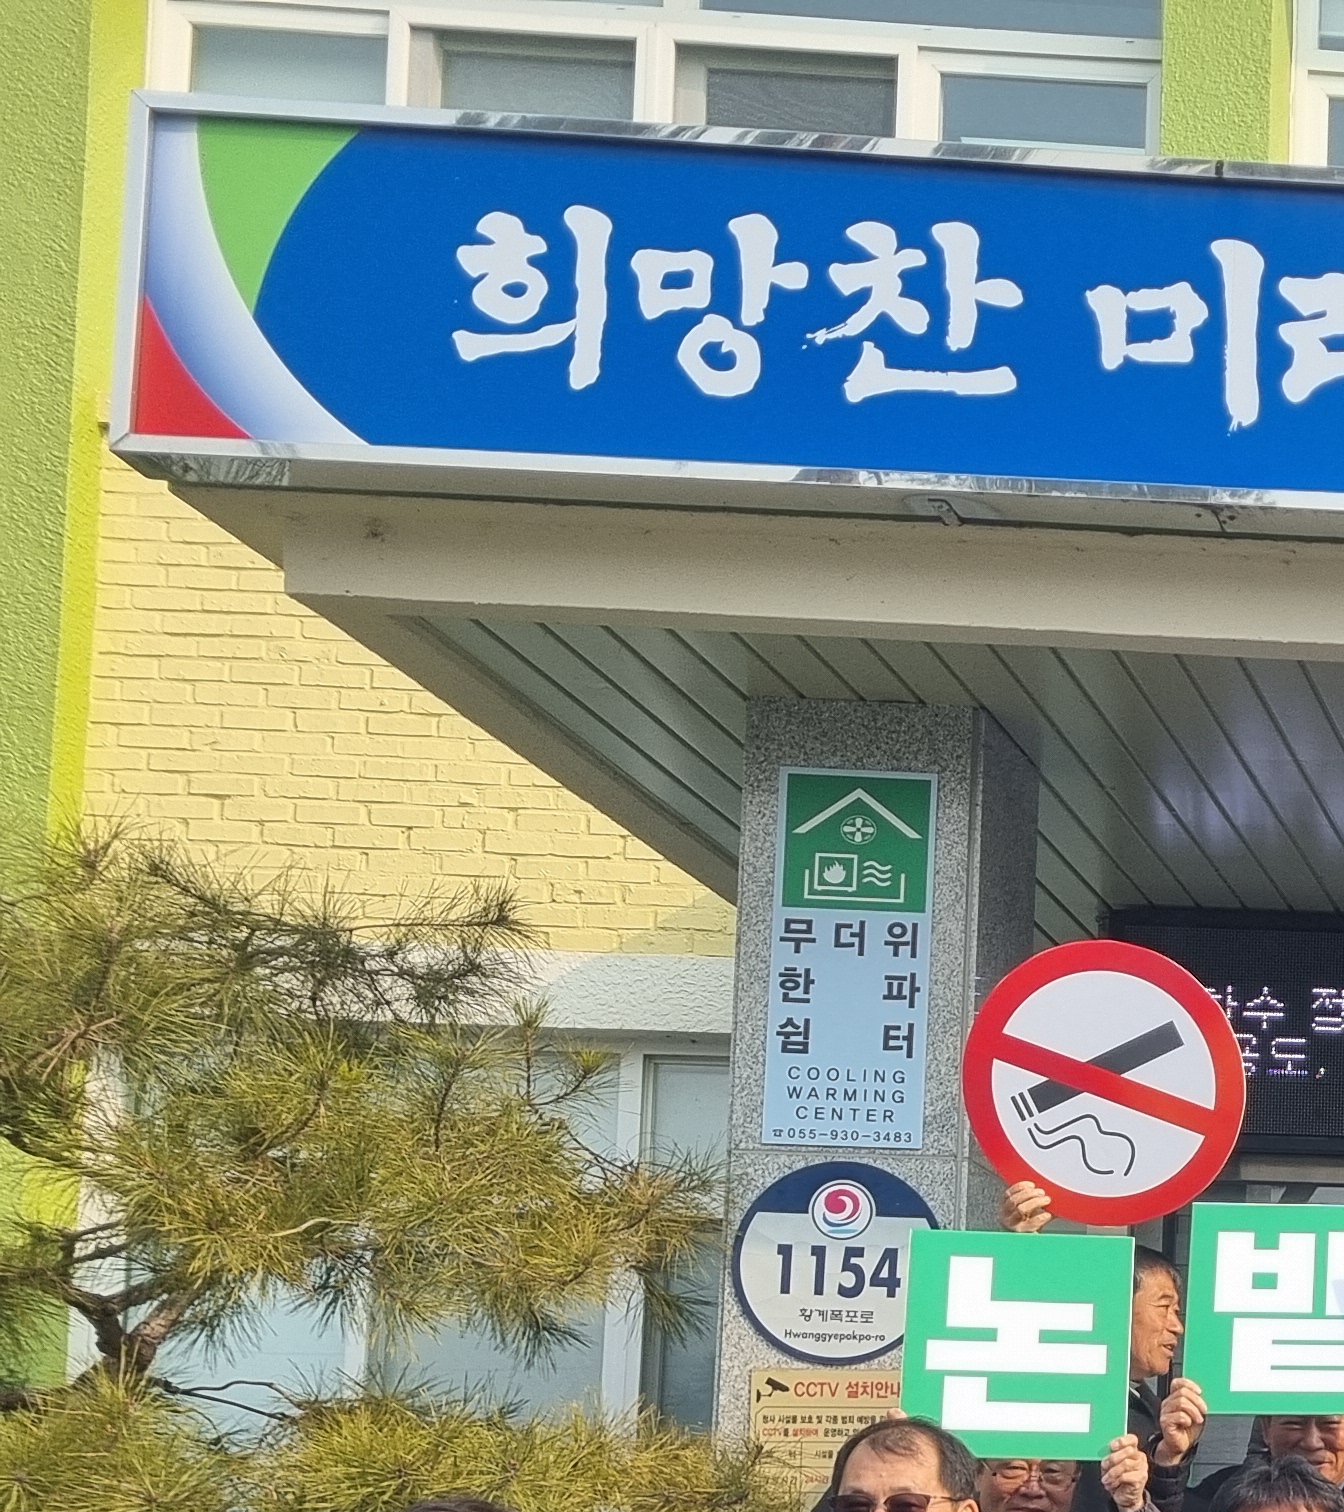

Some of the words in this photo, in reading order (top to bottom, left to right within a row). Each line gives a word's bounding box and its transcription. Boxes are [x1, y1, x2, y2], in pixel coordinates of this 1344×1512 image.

[453, 205, 1023, 402] 희망찬
[780, 918, 919, 959] 무더위
[778, 966, 921, 1008] 한파
[776, 1017, 915, 1058] 쉼터
[788, 1066, 905, 1084] COOLING
[787, 1085, 905, 1104] WARMING
[795, 1105, 894, 1123] CENTER
[777, 1244, 901, 1299] 1154
[799, 1308, 874, 1323] 황계폭포로
[784, 1329, 886, 1343] Hwanggyepokpo-ro
[926, 1256, 1107, 1432] 논
[794, 1381, 839, 1397] CCTV
